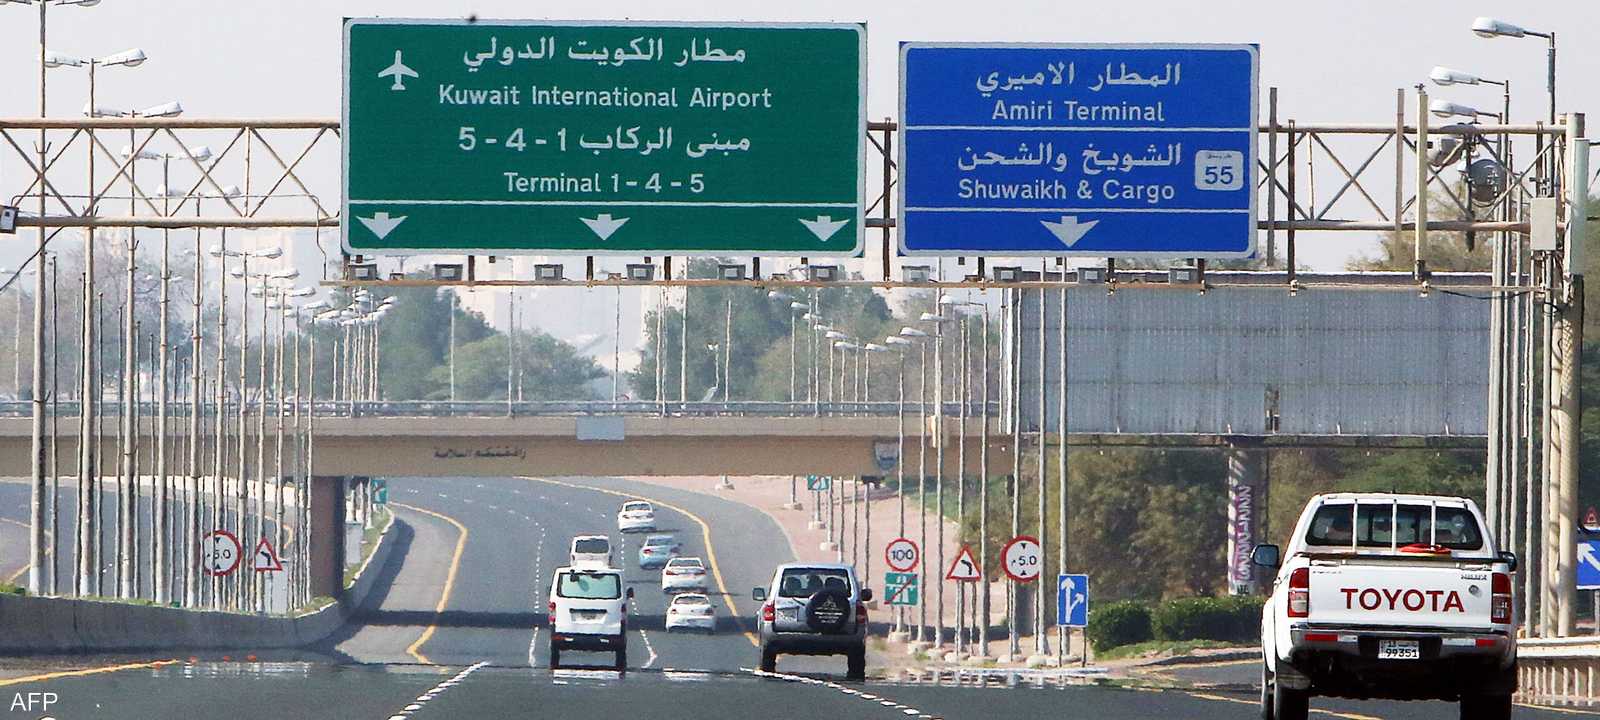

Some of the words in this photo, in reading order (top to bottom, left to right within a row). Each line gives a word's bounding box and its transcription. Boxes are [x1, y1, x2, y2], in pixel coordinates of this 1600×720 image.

[463, 36, 555, 72] الدولي
[568, 37, 663, 67] الكويت
[675, 37, 746, 67] مطار
[976, 62, 1075, 97] الاميري
[1088, 63, 1181, 92] المطار
[439, 84, 520, 106] Kuwait
[532, 86, 678, 108] International
[689, 88, 772, 111] Airport
[991, 99, 1053, 121] Amiri
[1063, 100, 1165, 122] Terminal
[579, 127, 673, 157] الركاب
[686, 132, 751, 158] مبنى
[958, 143, 1068, 172] والشحن
[1082, 143, 1181, 175] الشويخ
[503, 172, 602, 193] Terminal
[1204, 165, 1234, 185] 55
[958, 178, 1067, 200] Shuwaikh
[1076, 180, 1093, 199] &
[1102, 180, 1175, 204] Cargo
[892, 545, 915, 561] 100
[1019, 555, 1037, 566] 5.0
[1340, 586, 1465, 613] TOYOTA
[1385, 648, 1418, 658] 99351
